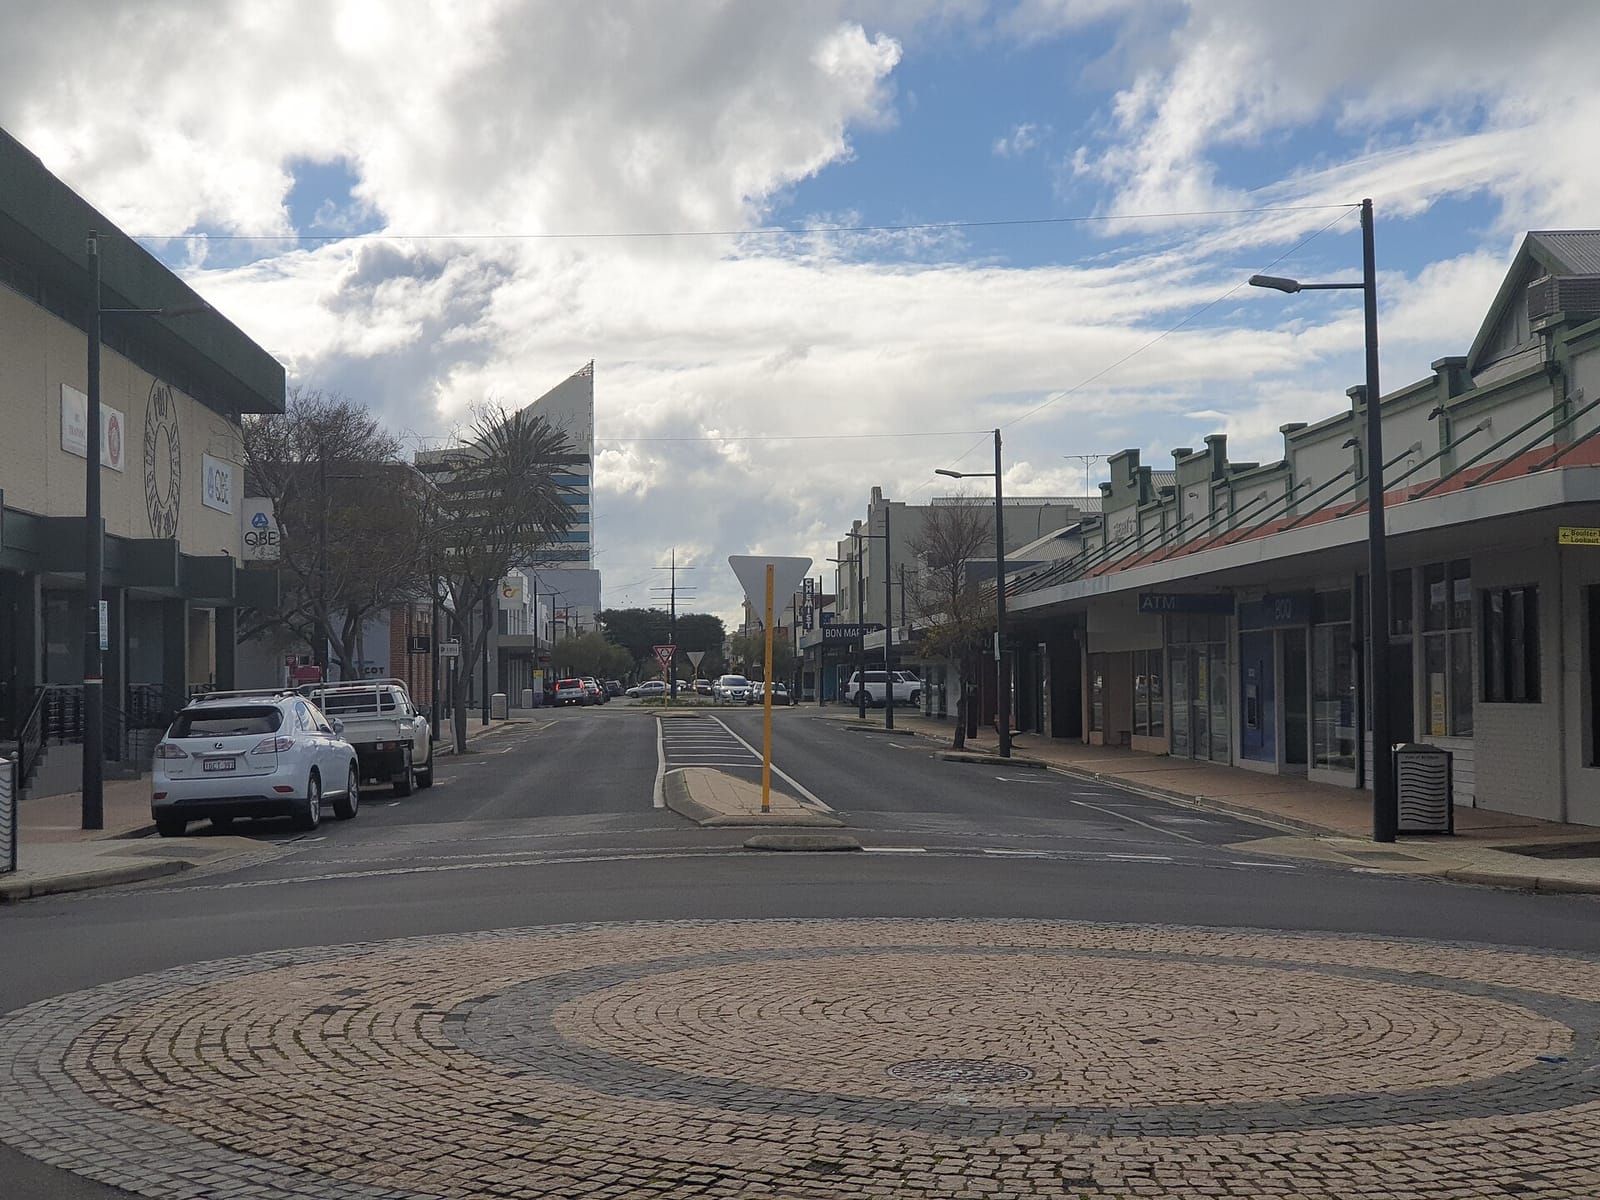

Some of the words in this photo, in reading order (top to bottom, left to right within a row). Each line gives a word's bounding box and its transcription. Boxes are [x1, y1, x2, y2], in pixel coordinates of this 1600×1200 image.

[244, 531, 276, 546] QBE
[804, 579, 814, 629] CHEMIST
[1142, 596, 1176, 610] ATM
[825, 628, 842, 638] BON
